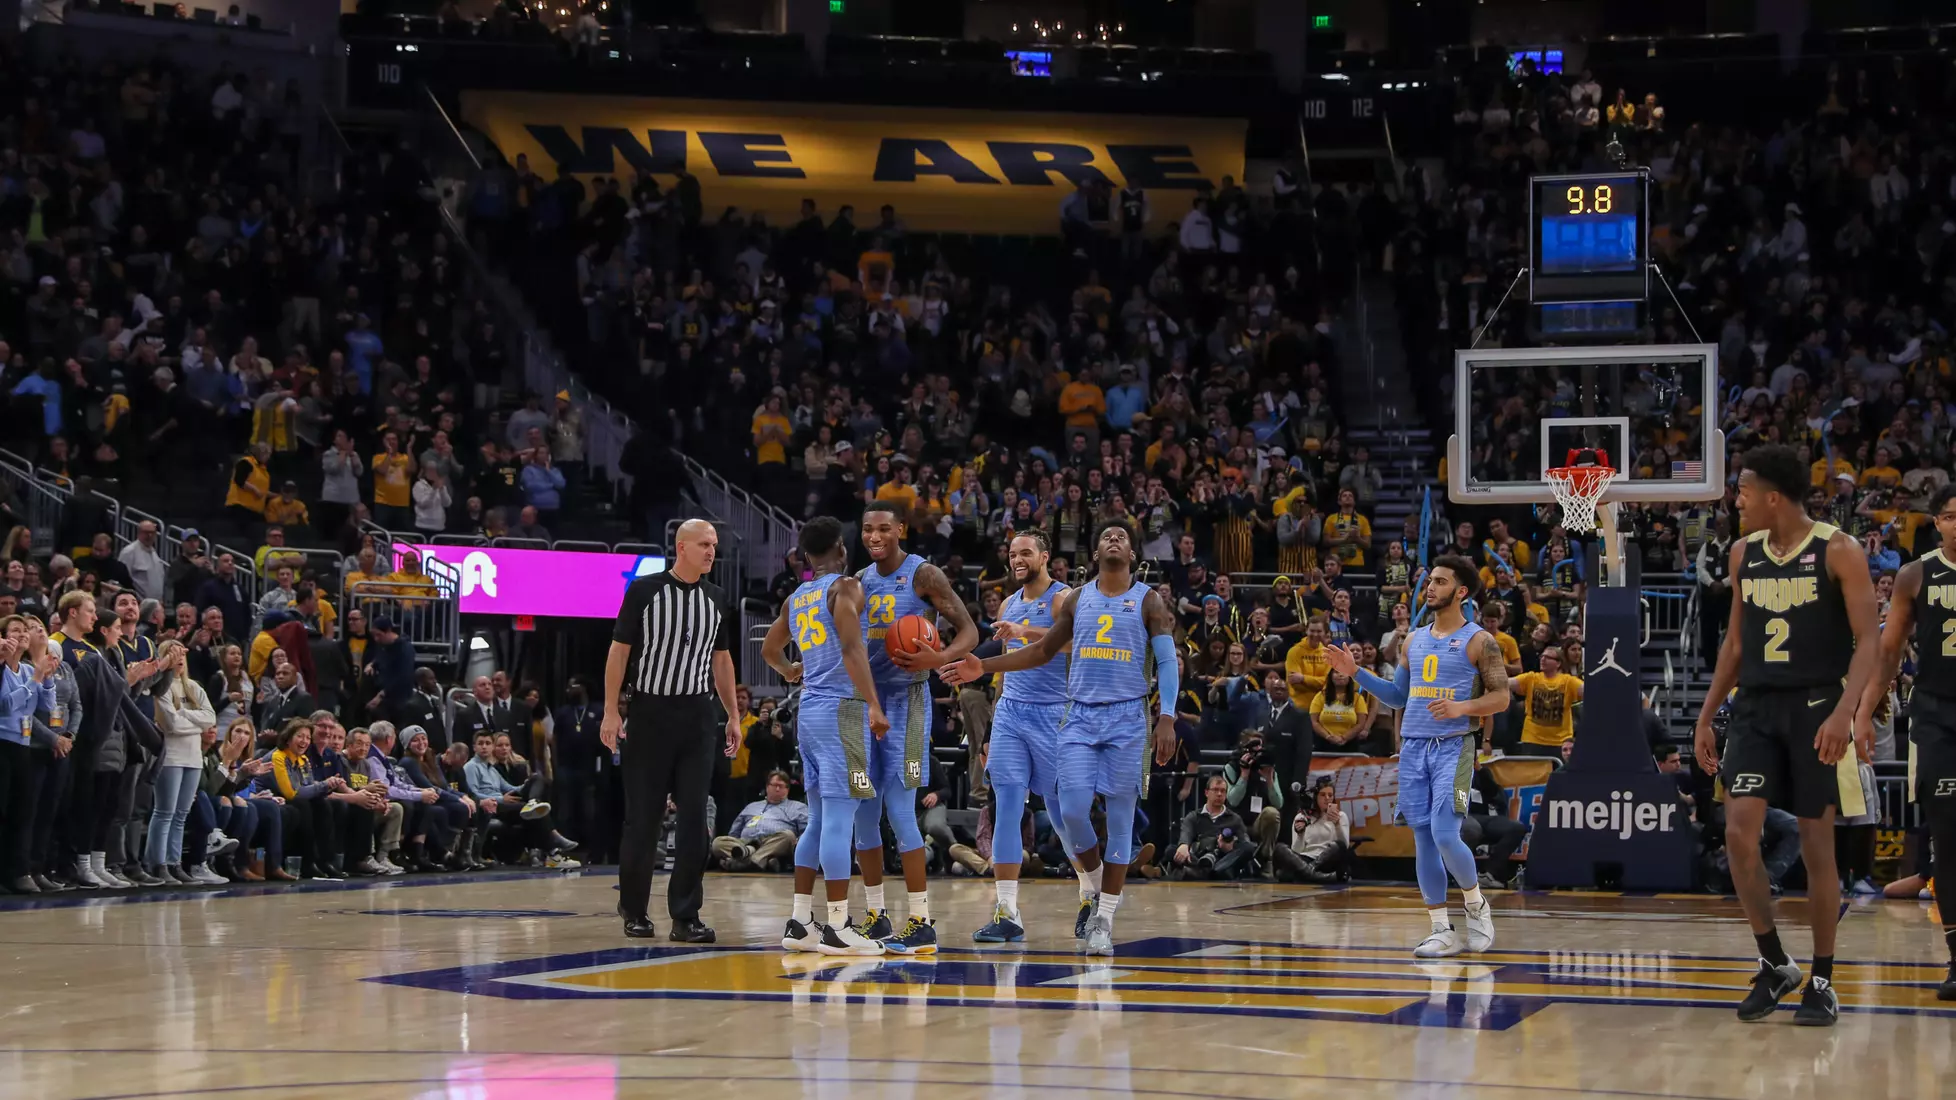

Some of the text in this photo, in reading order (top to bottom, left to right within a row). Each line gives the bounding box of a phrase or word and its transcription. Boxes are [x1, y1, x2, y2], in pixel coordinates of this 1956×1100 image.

[377, 63, 401, 83] 110
[1304, 98, 1373, 118] 110 112
[524, 123, 1217, 189] WE ARE
[1566, 185, 1612, 214] 9.8
[868, 594, 896, 624] 23
[1741, 576, 1819, 612] PURDUE
[796, 606, 827, 653] 25
[1095, 614, 1114, 644] 2
[1764, 618, 1790, 662] 2
[1079, 647, 1132, 662] MARQUETTE
[1422, 654, 1439, 682] 0
[1731, 773, 1766, 793] P
[1549, 790, 1676, 840] meijer
